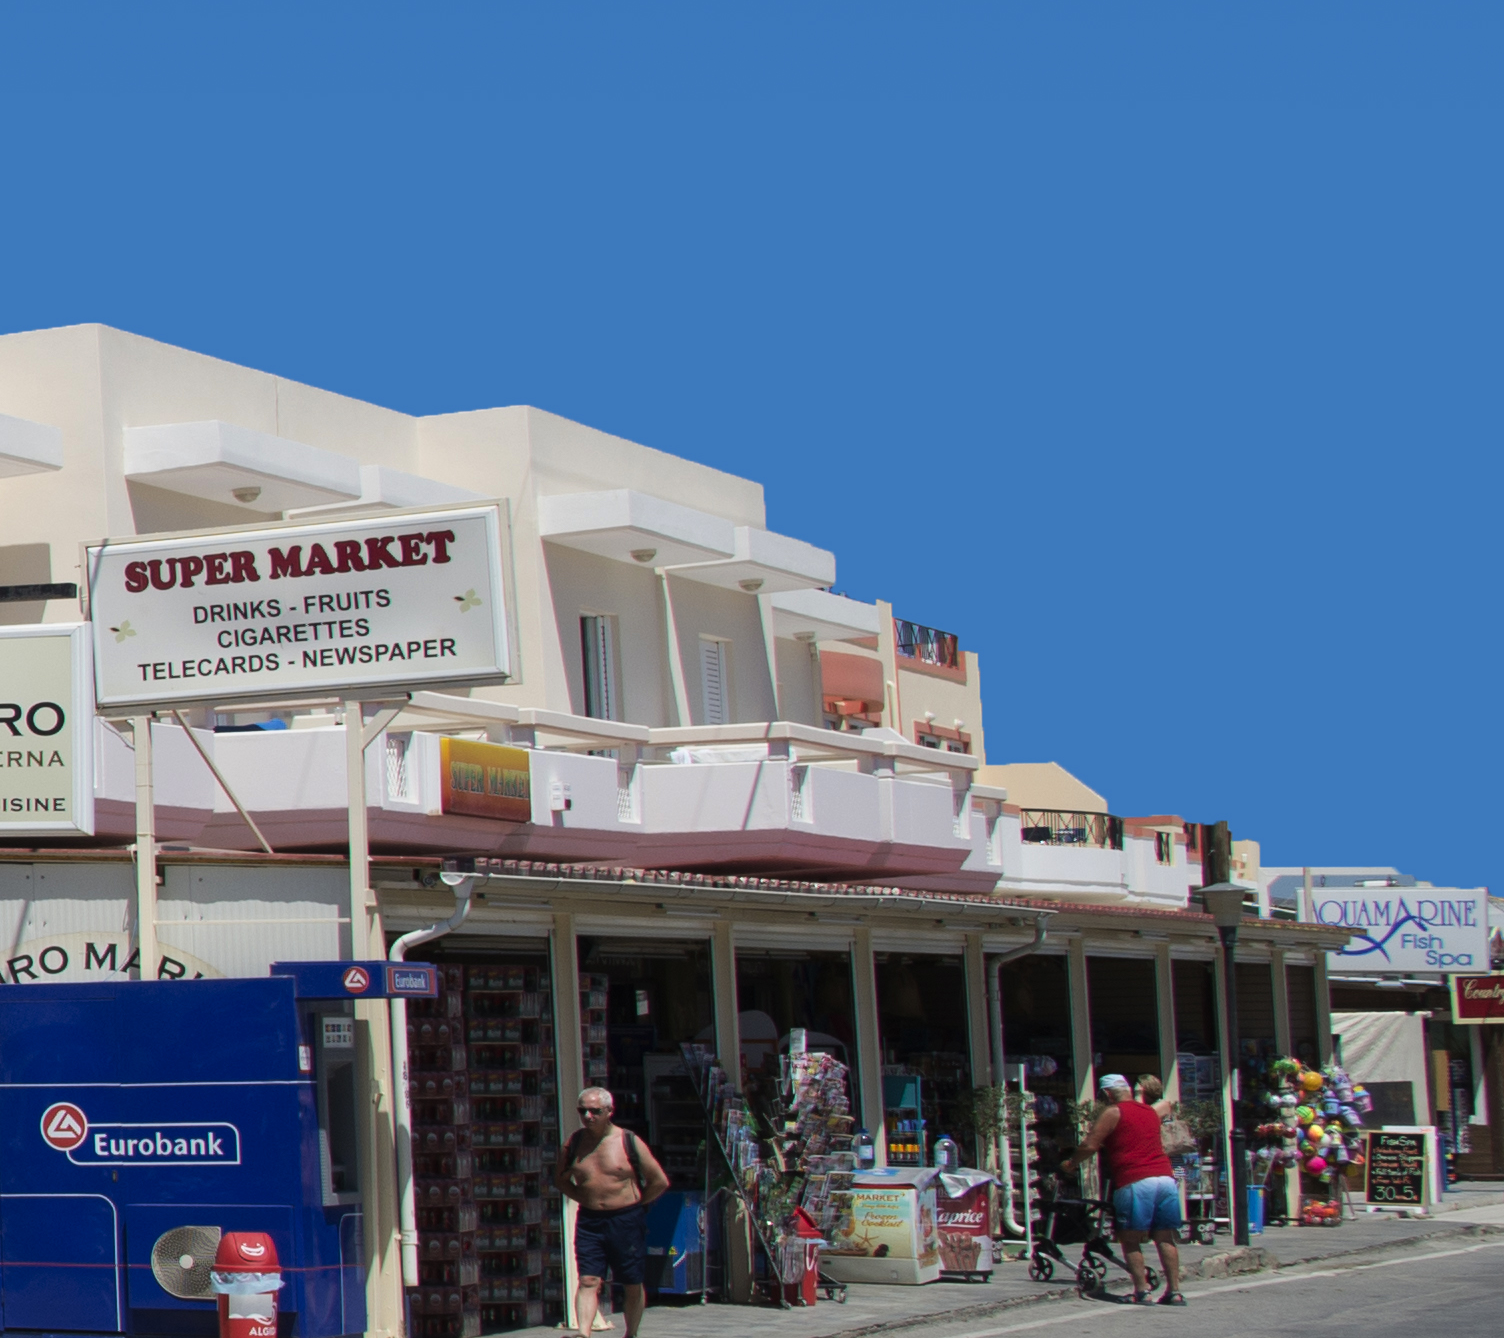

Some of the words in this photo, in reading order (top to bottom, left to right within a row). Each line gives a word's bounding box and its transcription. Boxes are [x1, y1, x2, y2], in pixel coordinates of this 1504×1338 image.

[124, 550, 259, 593] SUPER
[268, 530, 456, 580] MARKET
[193, 599, 281, 624] DRINKS
[304, 590, 391, 614] FRUITS
[217, 618, 370, 648] CIGARETTES
[138, 653, 280, 681] TELECARDS
[303, 638, 457, 668] NEWSPAPER
[1401, 933, 1443, 950] Fish
[84, 942, 204, 980] MAR
[1425, 951, 1474, 968] Spa
[394, 973, 426, 989] Eurobank
[94, 1133, 224, 1157] Eurobank
